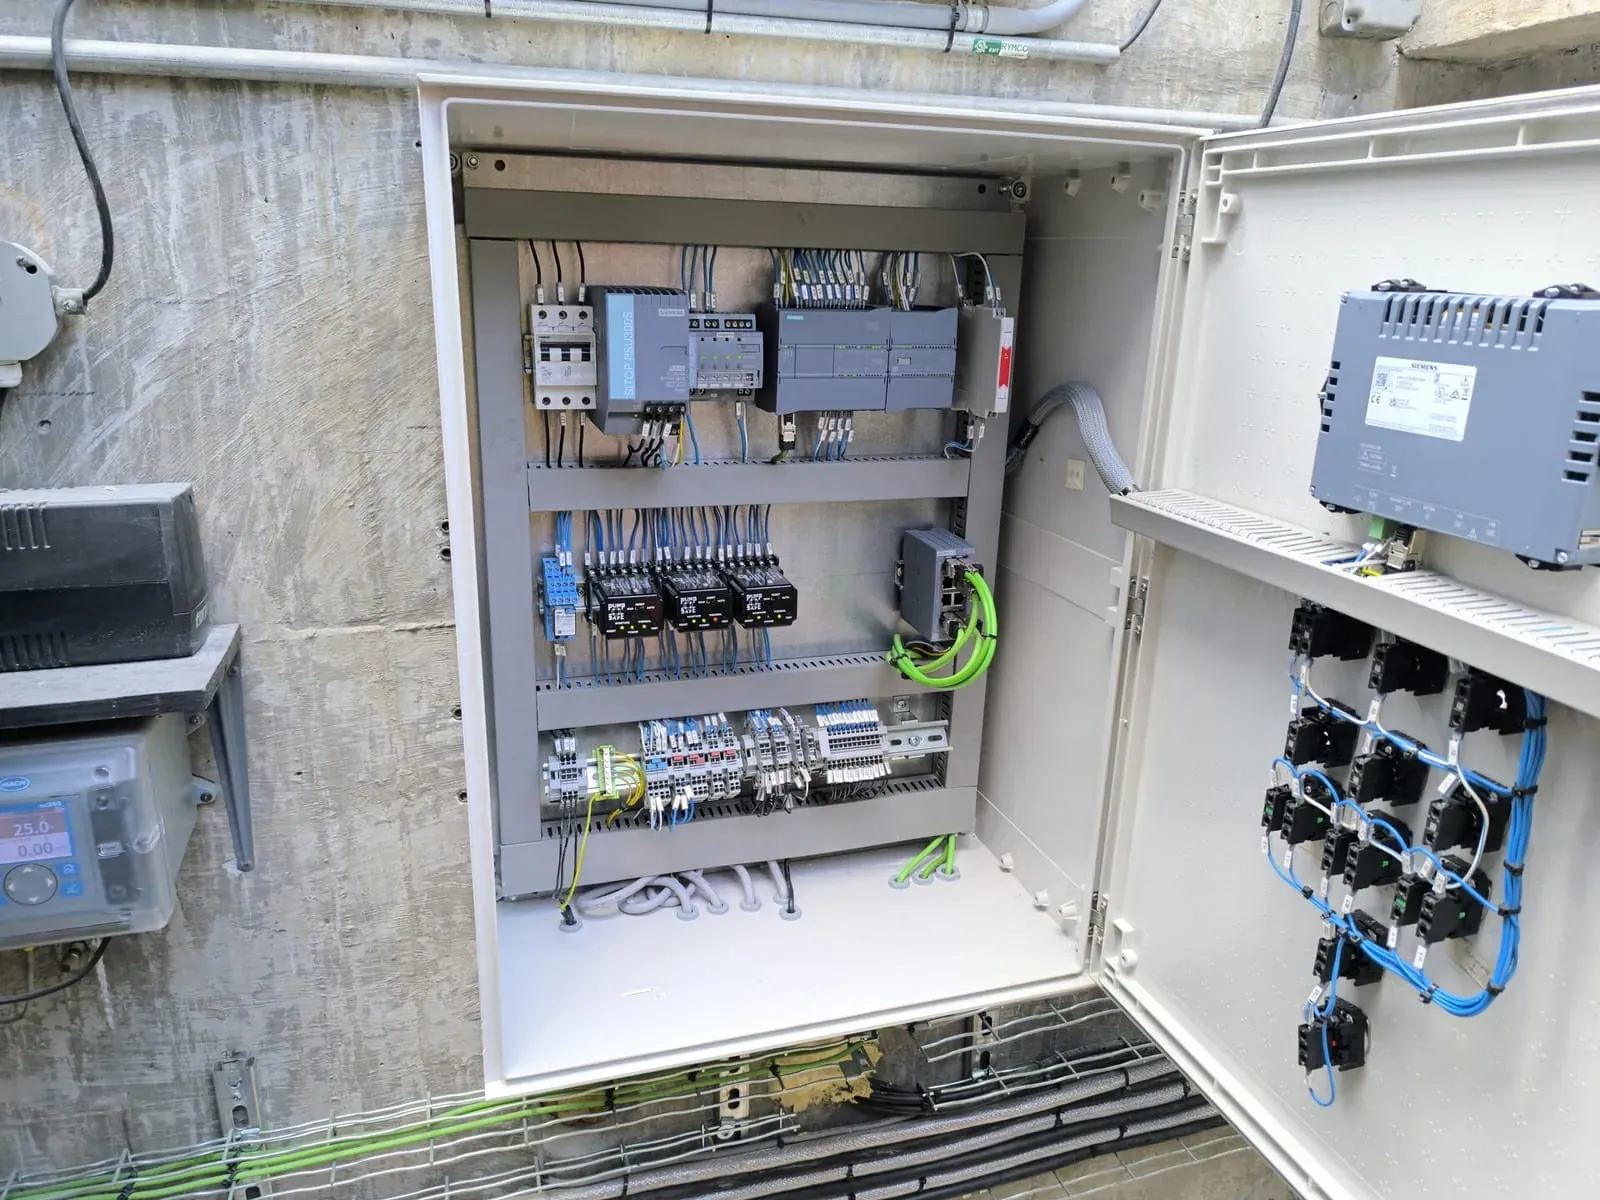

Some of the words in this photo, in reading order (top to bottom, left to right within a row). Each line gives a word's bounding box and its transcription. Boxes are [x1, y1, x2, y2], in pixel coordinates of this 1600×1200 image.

[1003, 43, 1029, 52] RYMCO
[1411, 362, 1438, 371] SIEMENS
[624, 363, 634, 396] SITOP
[607, 602, 625, 611] PUMP
[608, 612, 624, 620] SAFE
[13, 821, 49, 836] 25.0
[18, 842, 53, 857] 0.00
